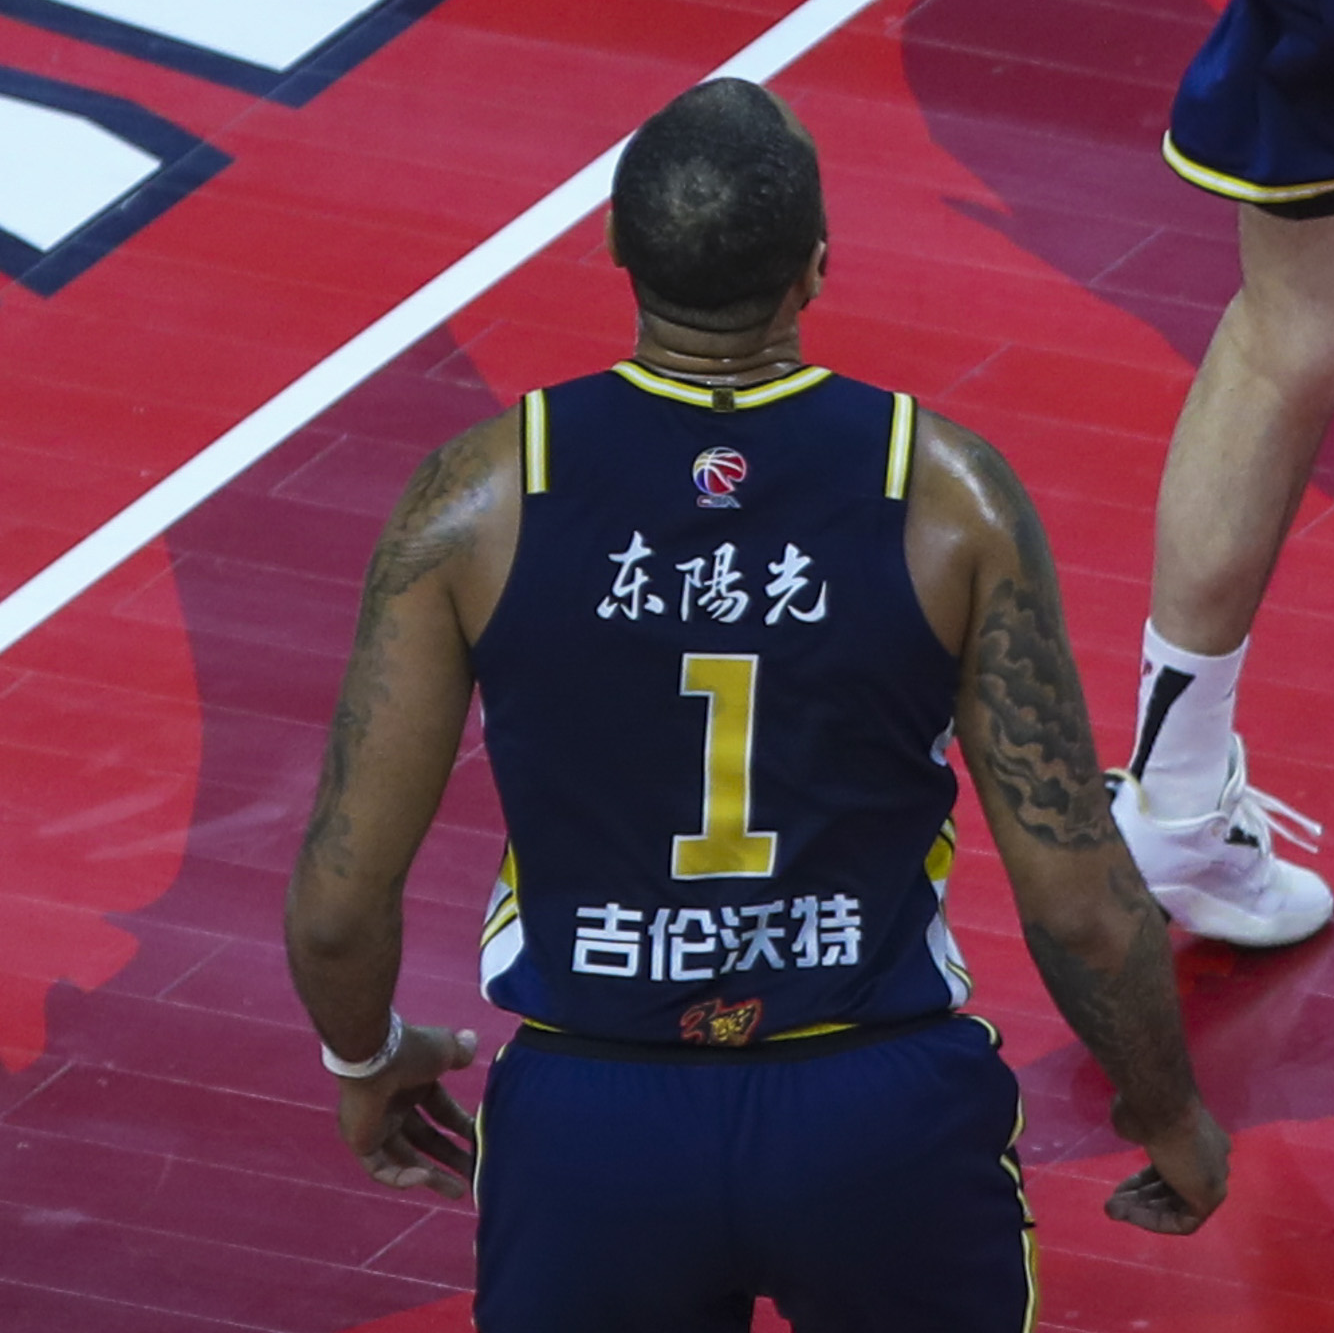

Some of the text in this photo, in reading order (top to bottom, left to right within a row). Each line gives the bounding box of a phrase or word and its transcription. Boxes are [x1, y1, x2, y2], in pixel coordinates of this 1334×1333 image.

[669, 652, 779, 881] 1
[570, 892, 862, 982] 吉伦沃特
